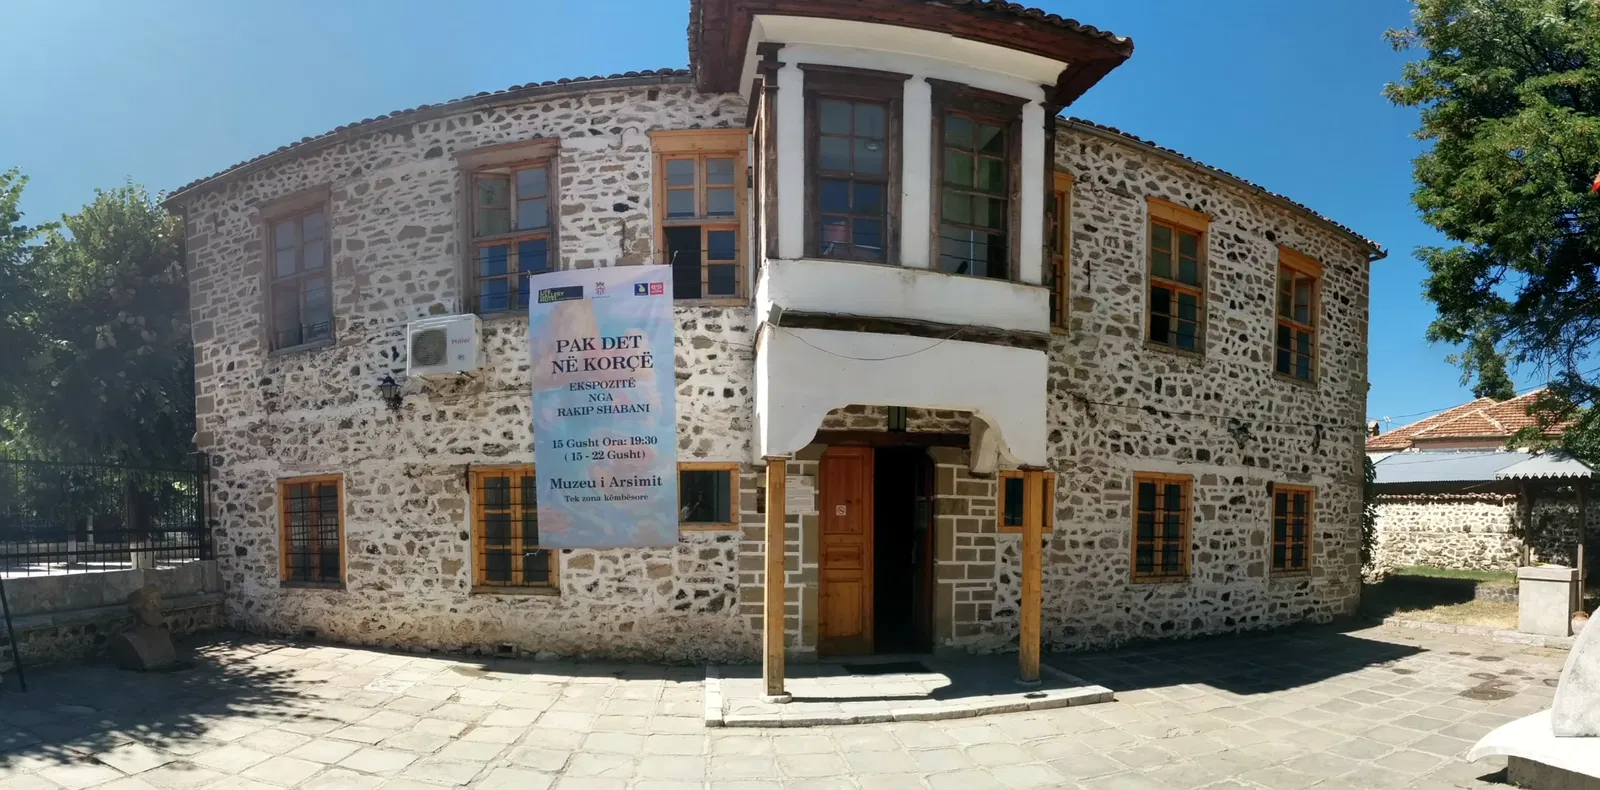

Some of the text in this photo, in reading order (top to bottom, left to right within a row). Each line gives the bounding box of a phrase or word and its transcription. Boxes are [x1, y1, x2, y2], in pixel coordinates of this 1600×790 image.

[556, 335, 642, 353] PAK DET
[552, 351, 654, 374] NË KORÇË
[569, 377, 636, 391] EKSPOZITË
[588, 393, 614, 403] NGA
[557, 404, 650, 417] RAKIP SHABANI
[552, 435, 658, 449] 15 Gusht Ora: 19:30
[571, 452, 583, 461] 15
[591, 451, 605, 460] 22
[607, 449, 646, 460] Gusht)
[550, 475, 663, 490] Muzeu i Arsimit
[564, 495, 580, 503] Tek
[603, 493, 649, 502] këmbësore
